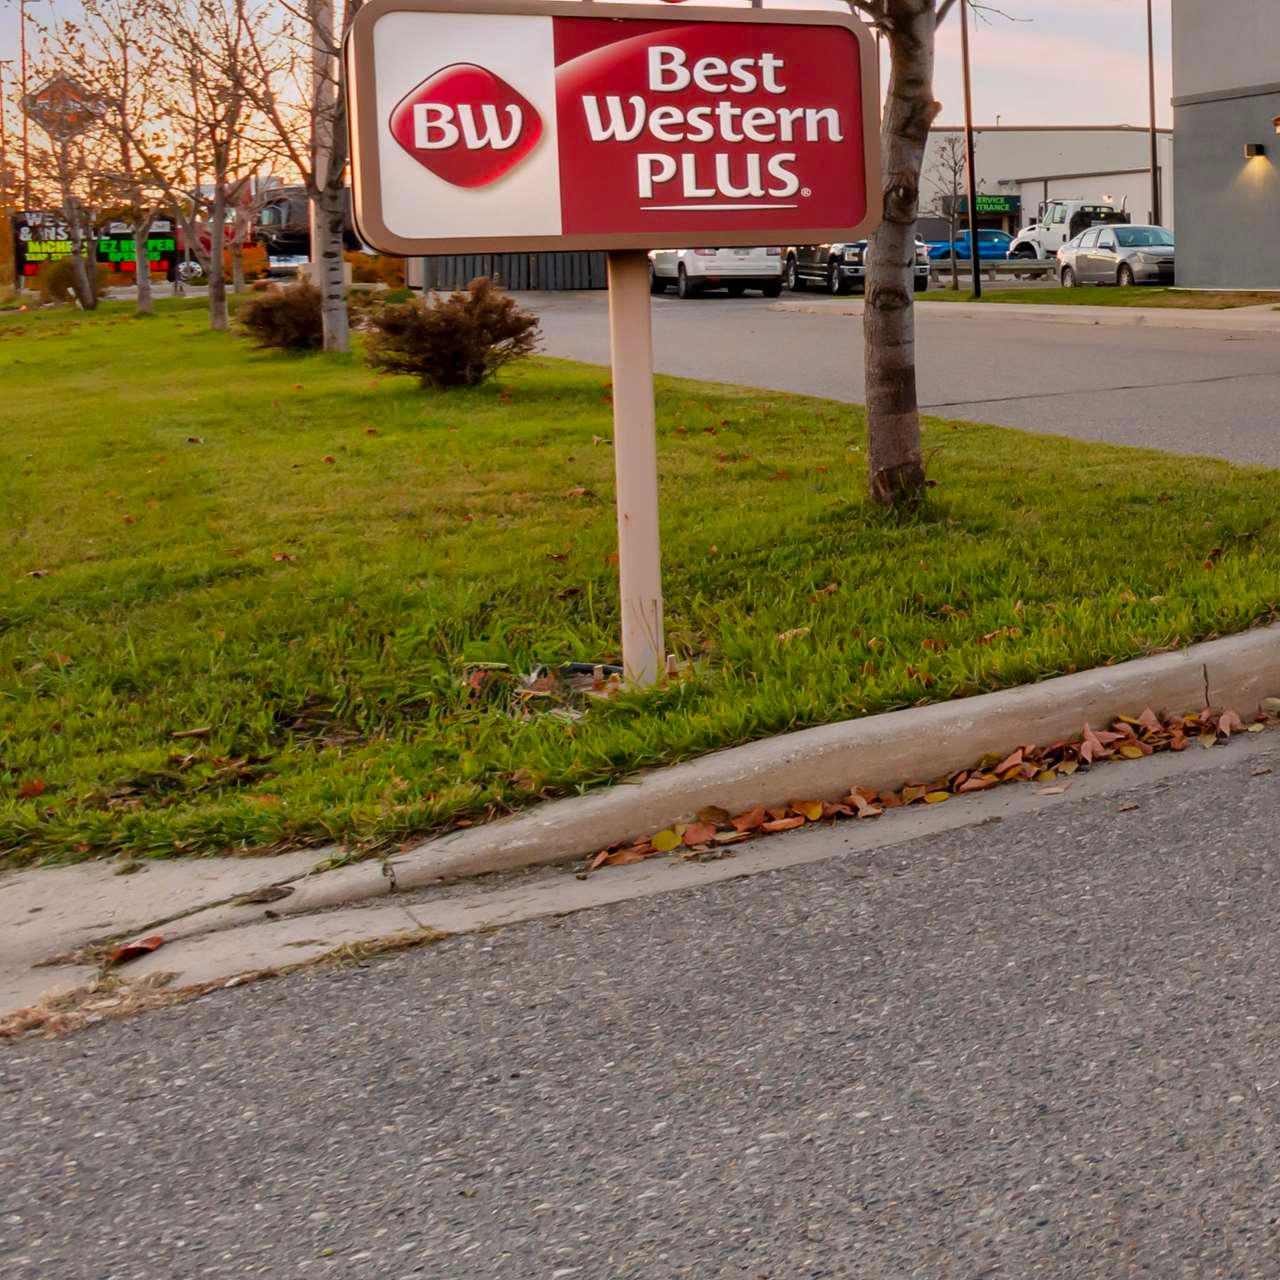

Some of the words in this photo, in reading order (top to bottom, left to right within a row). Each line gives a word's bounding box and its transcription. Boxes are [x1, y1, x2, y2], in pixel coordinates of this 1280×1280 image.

[647, 45, 786, 94] Best
[413, 102, 523, 151] BW
[582, 95, 843, 143] Western
[636, 152, 800, 199] PLUS
